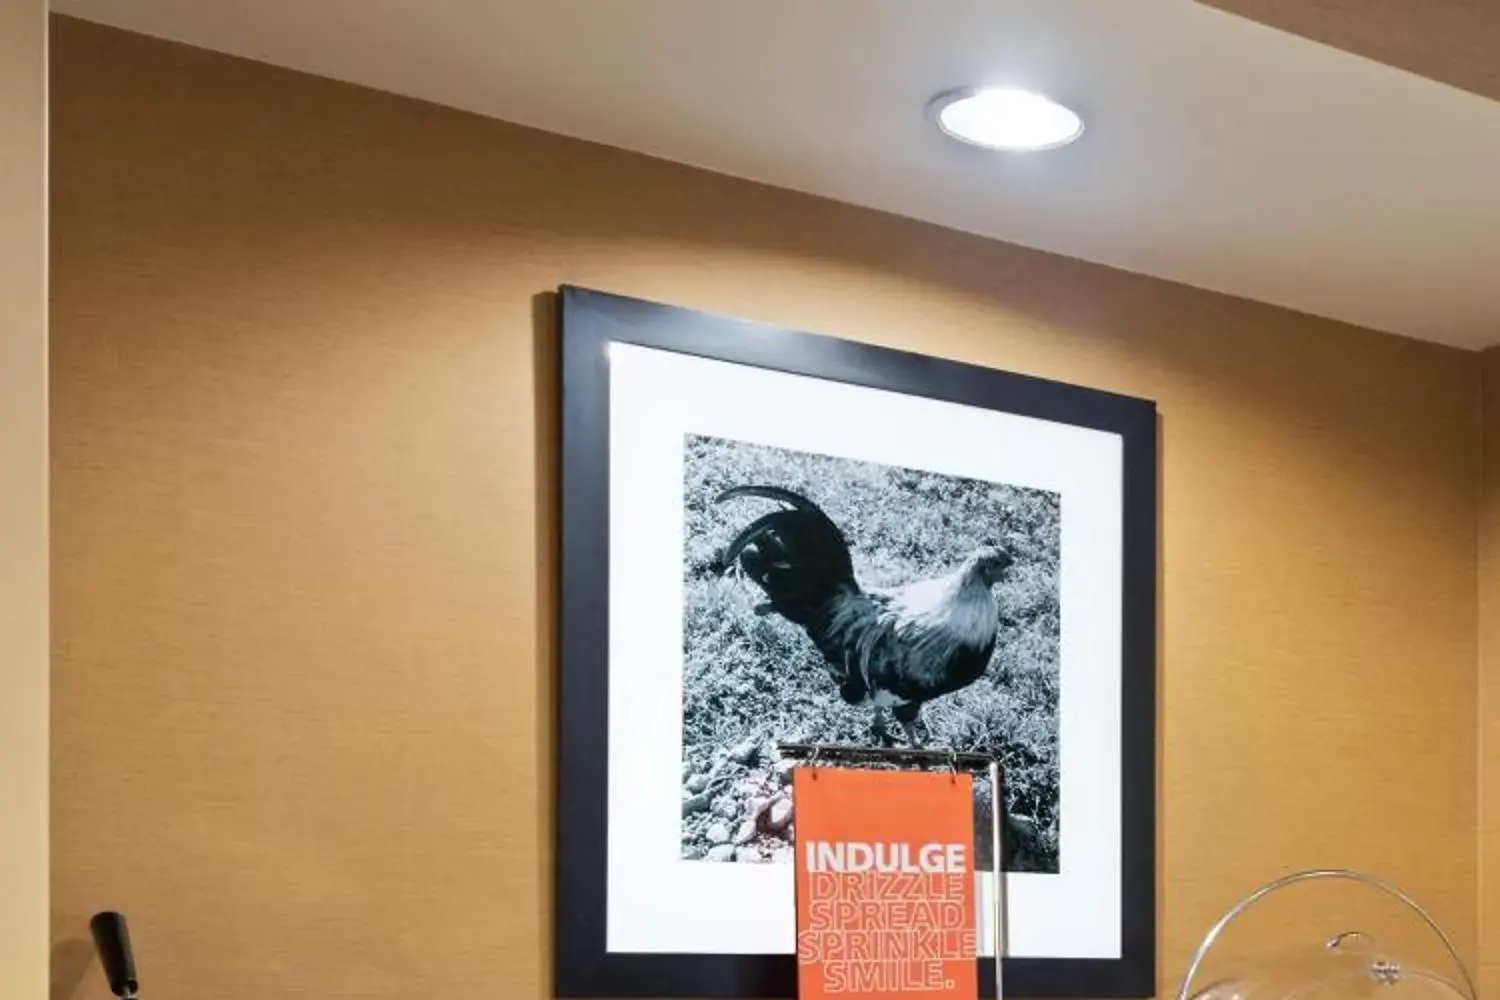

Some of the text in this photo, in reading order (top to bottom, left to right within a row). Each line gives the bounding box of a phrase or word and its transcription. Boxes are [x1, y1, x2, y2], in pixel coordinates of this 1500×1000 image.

[806, 841, 966, 873] INDULGE
[809, 871, 965, 901] DRIZZLE
[809, 900, 965, 931] SPREAD
[797, 929, 976, 964] SPRINKLE
[823, 959, 955, 993] SMILE.
